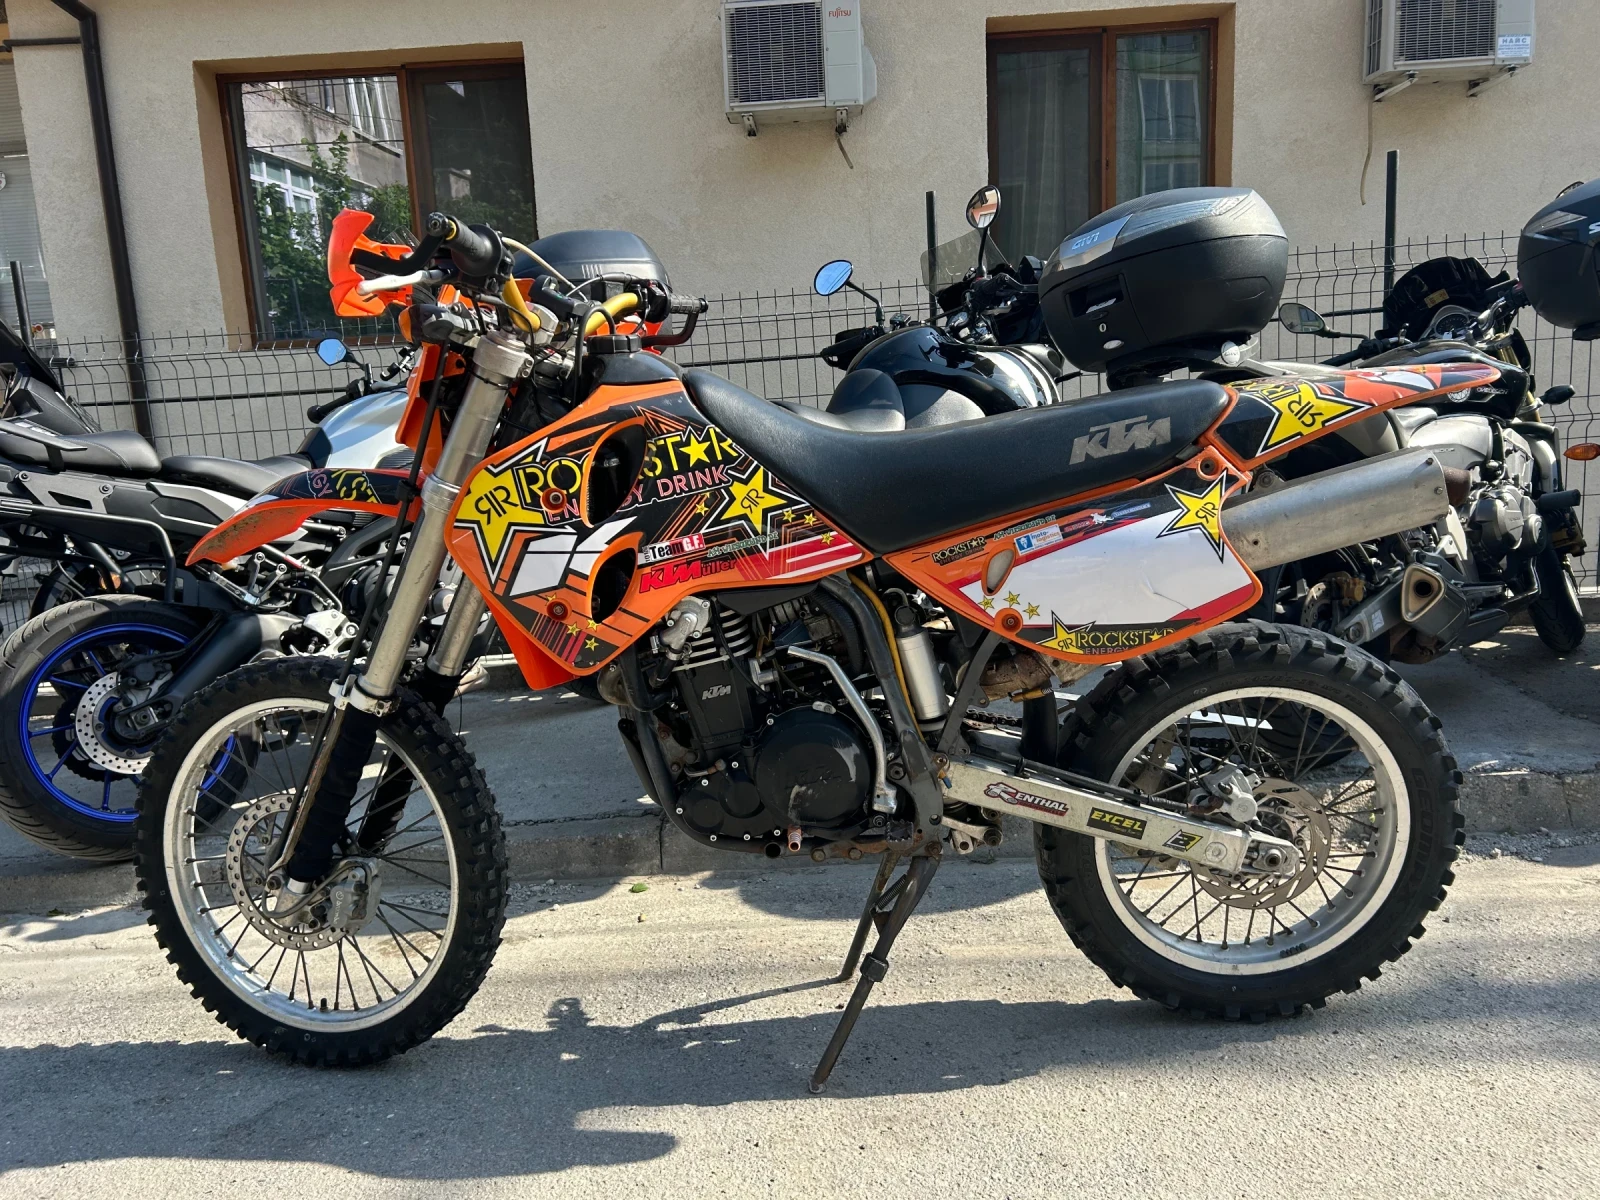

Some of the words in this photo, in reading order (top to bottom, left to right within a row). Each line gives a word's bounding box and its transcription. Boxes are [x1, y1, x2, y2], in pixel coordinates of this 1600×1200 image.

[828, 7, 852, 18] FUJITSU
[1071, 232, 1100, 250] GIVI
[1069, 415, 1171, 465] KTM
[656, 464, 729, 497] DRINK
[701, 684, 732, 700] KTM
[1091, 810, 1144, 830] EXCEL
